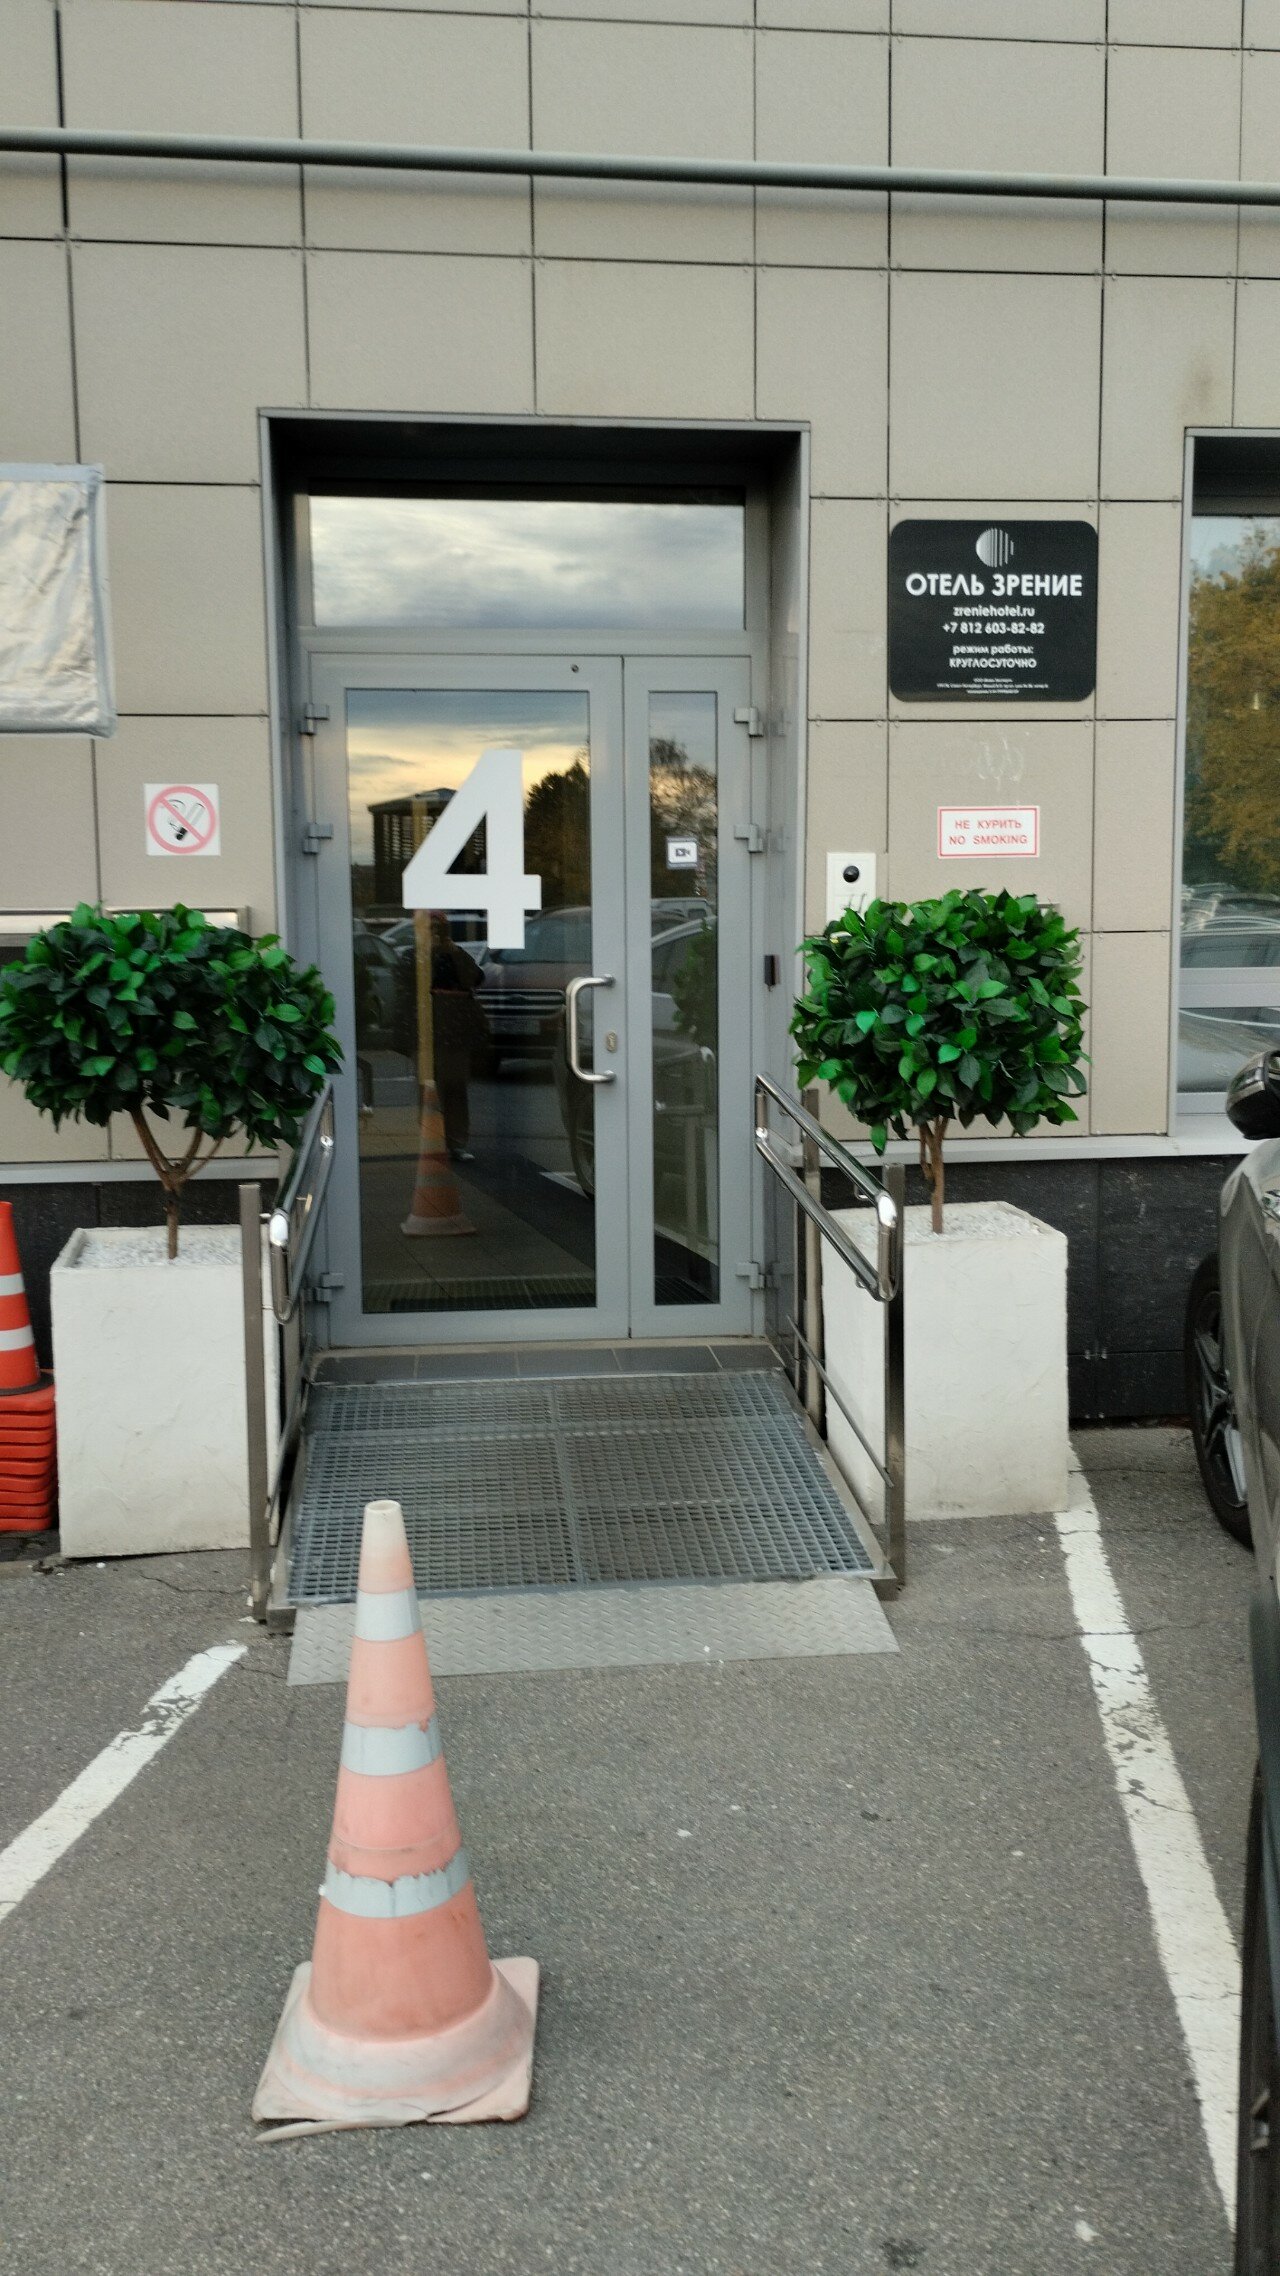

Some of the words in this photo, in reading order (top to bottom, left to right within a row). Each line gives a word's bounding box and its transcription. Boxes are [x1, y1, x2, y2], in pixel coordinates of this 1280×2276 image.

[906, 573, 985, 596] ОТЕЛЬ
[992, 574, 1082, 596] ЗРЕНИЕ
[953, 605, 1036, 617] zreniehotel.ru
[942, 622, 958, 634] +7
[960, 622, 983, 634] 812
[985, 622, 1045, 634] 603-82-82
[952, 645, 989, 656] режим
[990, 644, 1034, 656] работы:
[950, 658, 1037, 669] КРУГЛОСУТОЧНО
[955, 820, 970, 829] НЕ
[977, 819, 1022, 829] КУРИТЬ
[949, 835, 965, 845] NO
[973, 835, 1028, 845] SMOKING
[402, 749, 542, 951] 4
